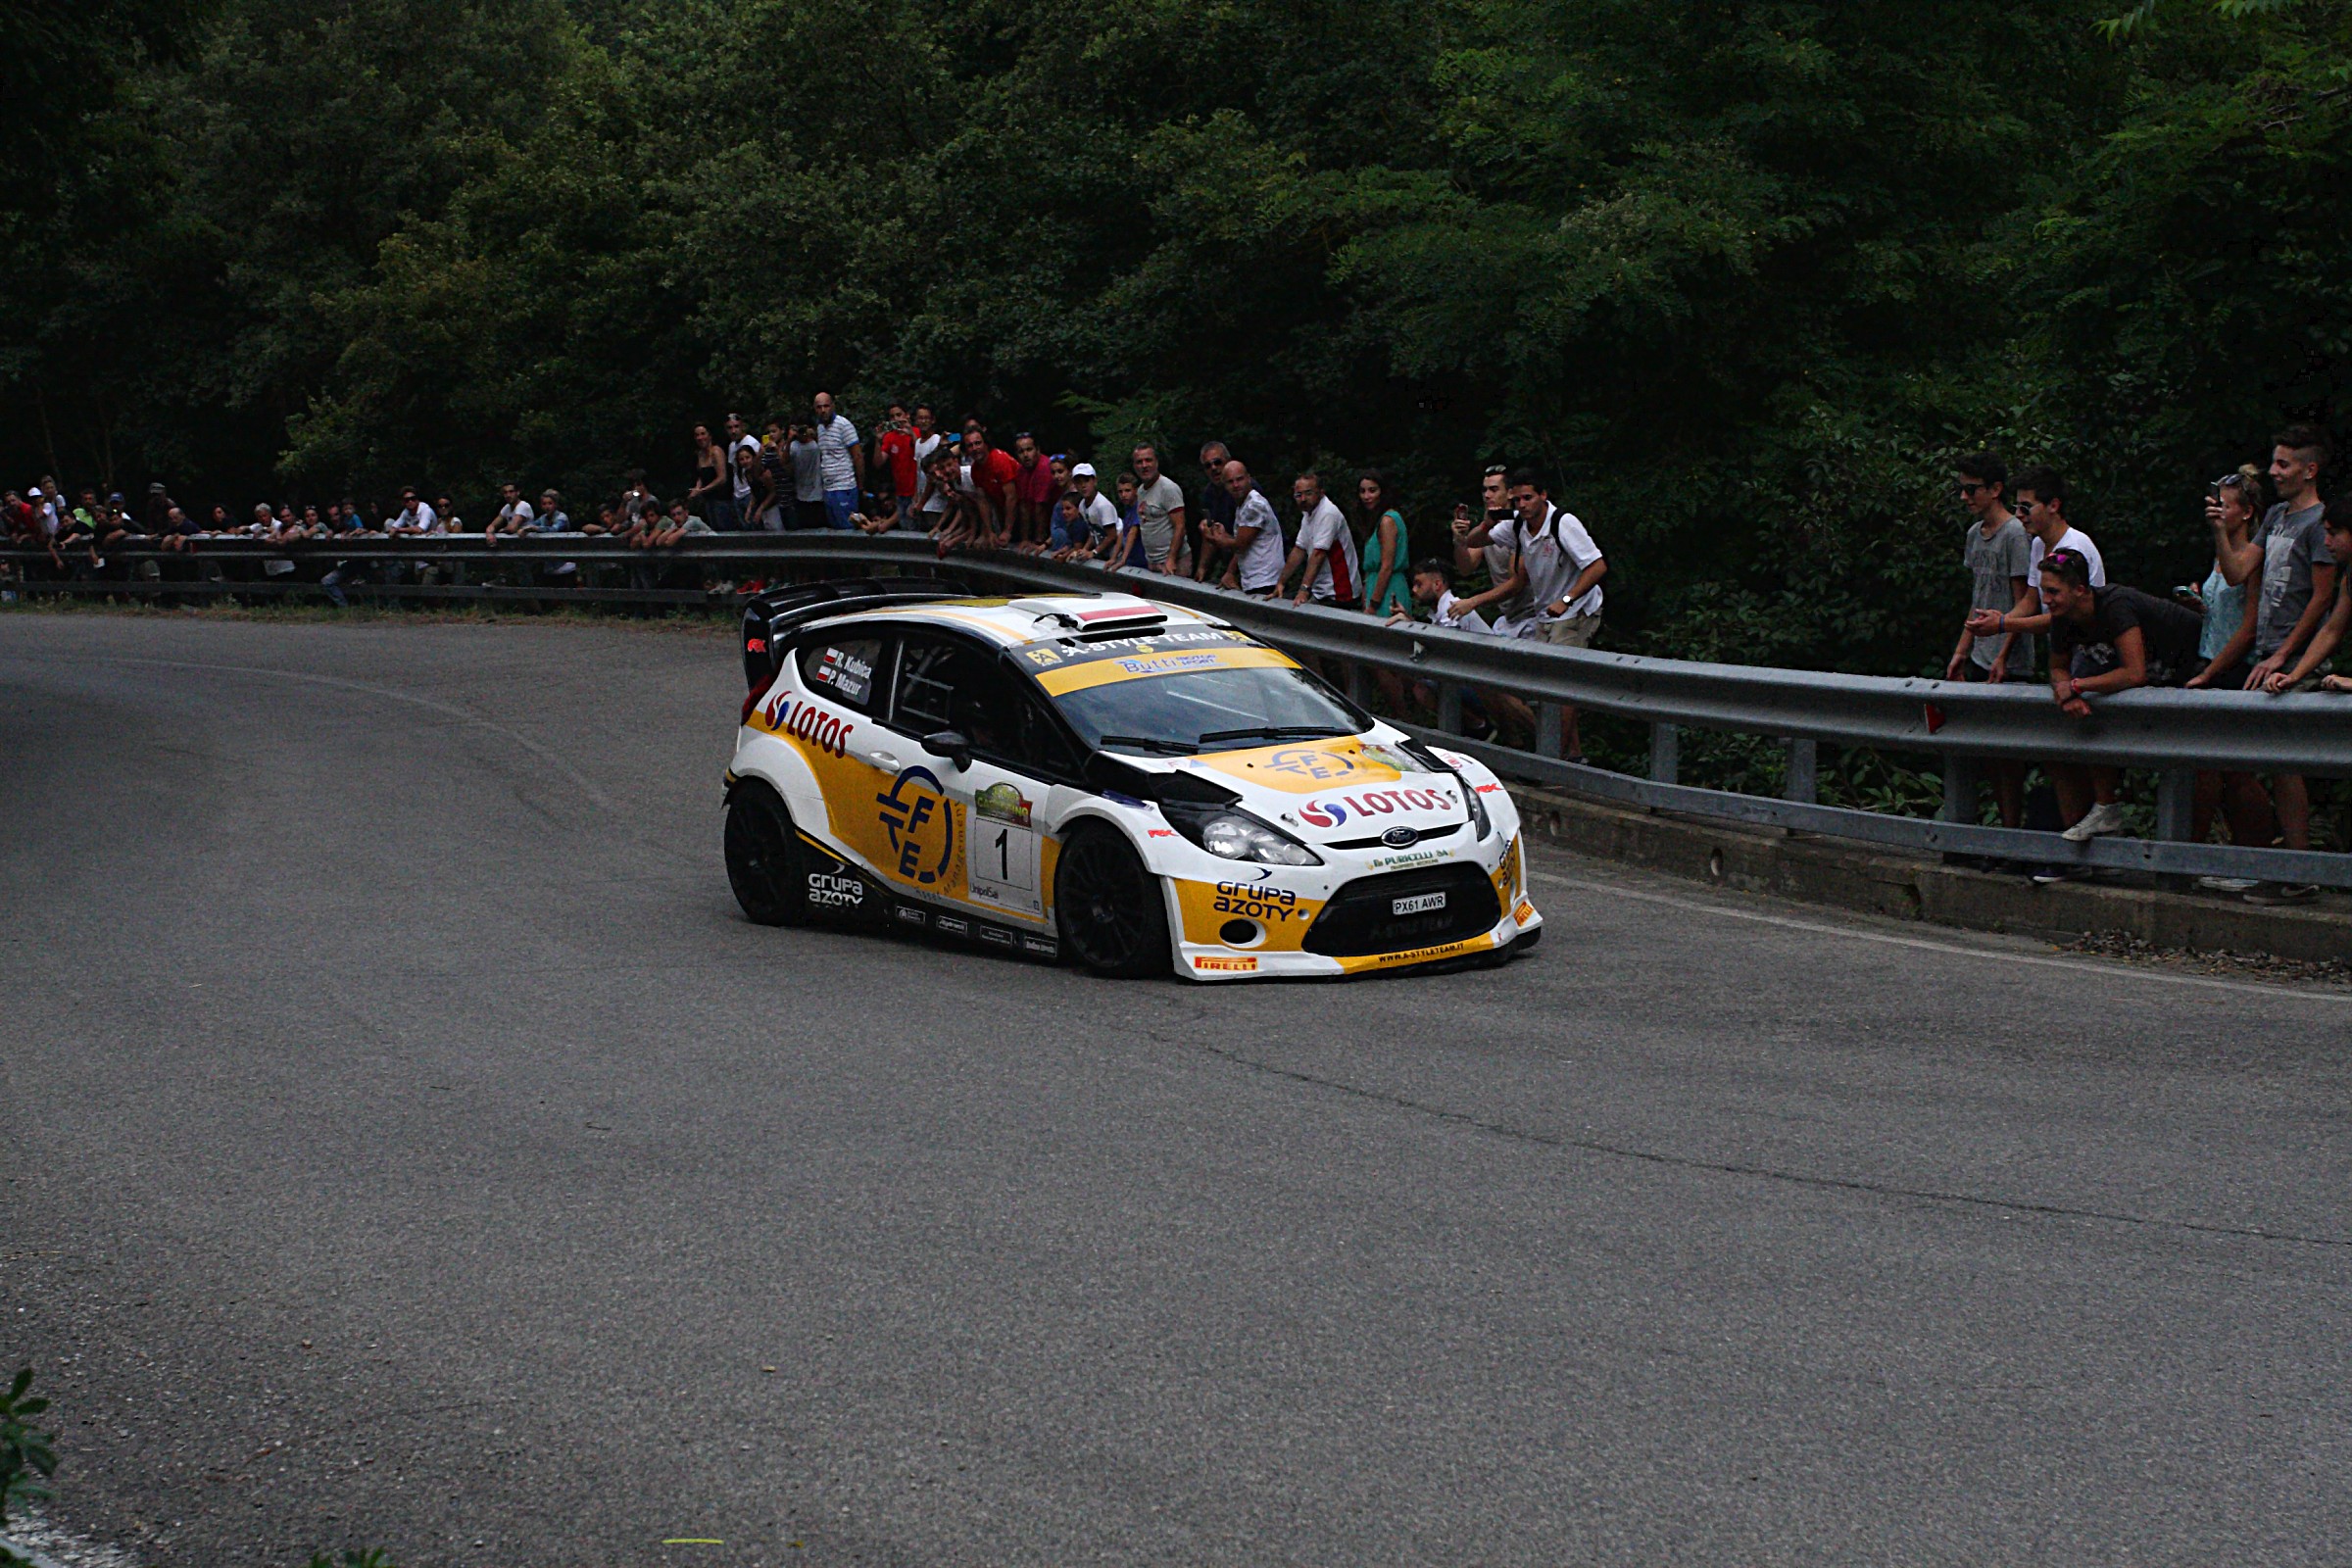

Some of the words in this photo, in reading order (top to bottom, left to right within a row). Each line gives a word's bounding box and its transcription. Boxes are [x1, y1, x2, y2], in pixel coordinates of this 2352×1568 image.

[1158, 632, 1224, 643] TEAM
[844, 655, 872, 679] Kubica
[835, 671, 862, 696] Mazur
[787, 701, 854, 759] LOTOS
[1343, 789, 1451, 816] LOTOS
[996, 829, 1007, 880] 1
[1396, 900, 1419, 912] PX61
[1421, 895, 1444, 908] AWR
[1195, 956, 1257, 970] PIRELLI
